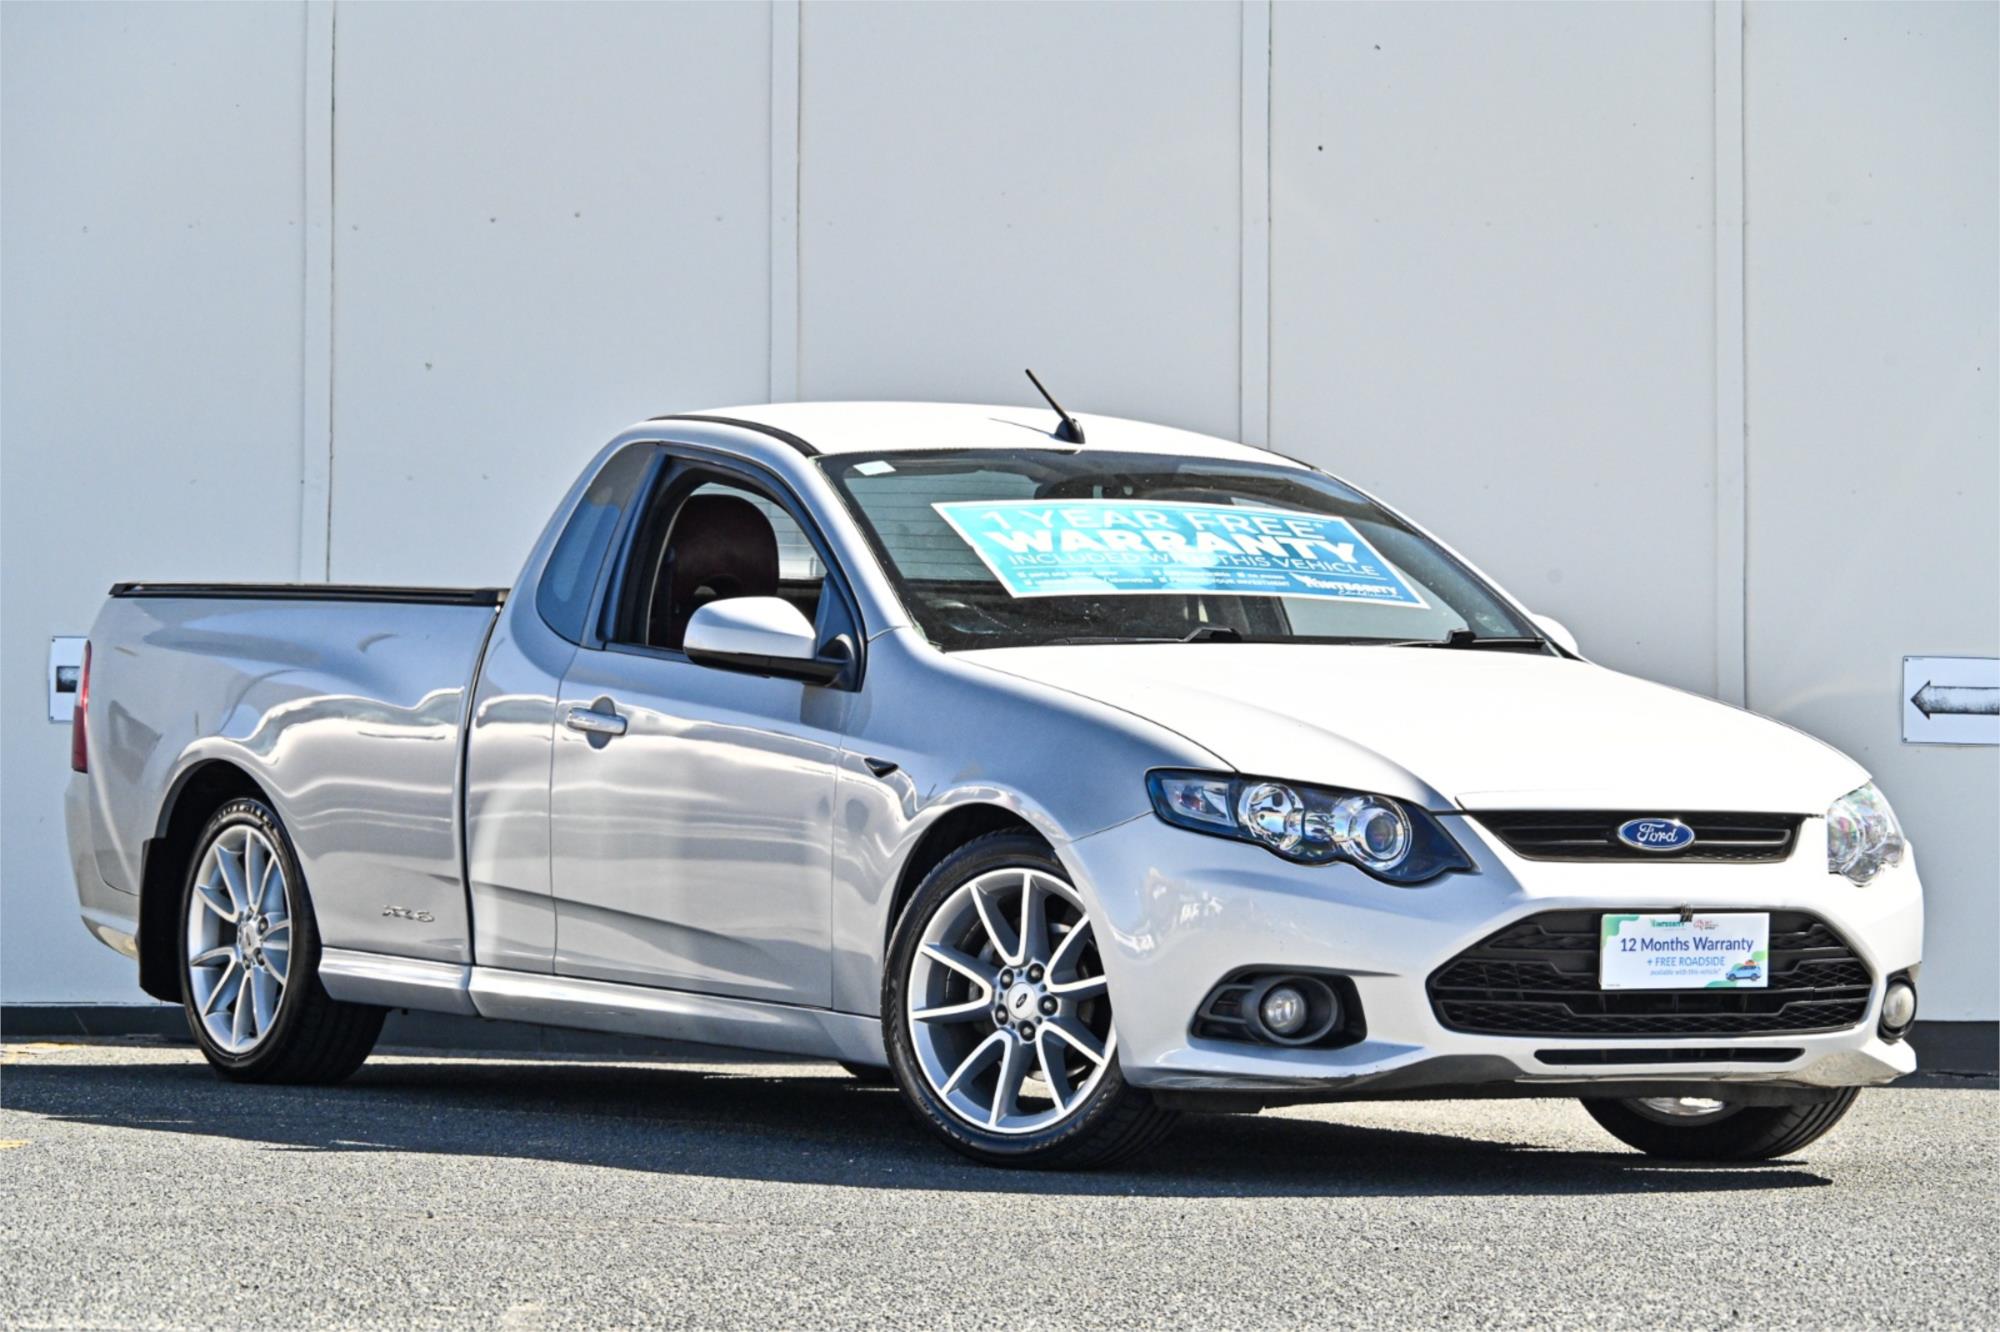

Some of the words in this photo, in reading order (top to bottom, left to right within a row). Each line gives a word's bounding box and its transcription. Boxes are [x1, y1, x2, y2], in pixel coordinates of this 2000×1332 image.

[981, 510, 1011, 530] 1
[1016, 508, 1179, 530] YEAR
[981, 529, 1358, 564] WARRANTY
[1007, 552, 1141, 566] INCLUDED
[1217, 553, 1271, 567] THIS
[1271, 556, 1381, 577] VEHICLE
[1636, 822, 1679, 842] Ford
[1620, 937, 1638, 952] 12
[1640, 936, 1690, 952] Months
[1692, 936, 1754, 953] Warranty
[1655, 956, 1677, 967] FREE
[1678, 956, 1726, 967] ROADSIDE
